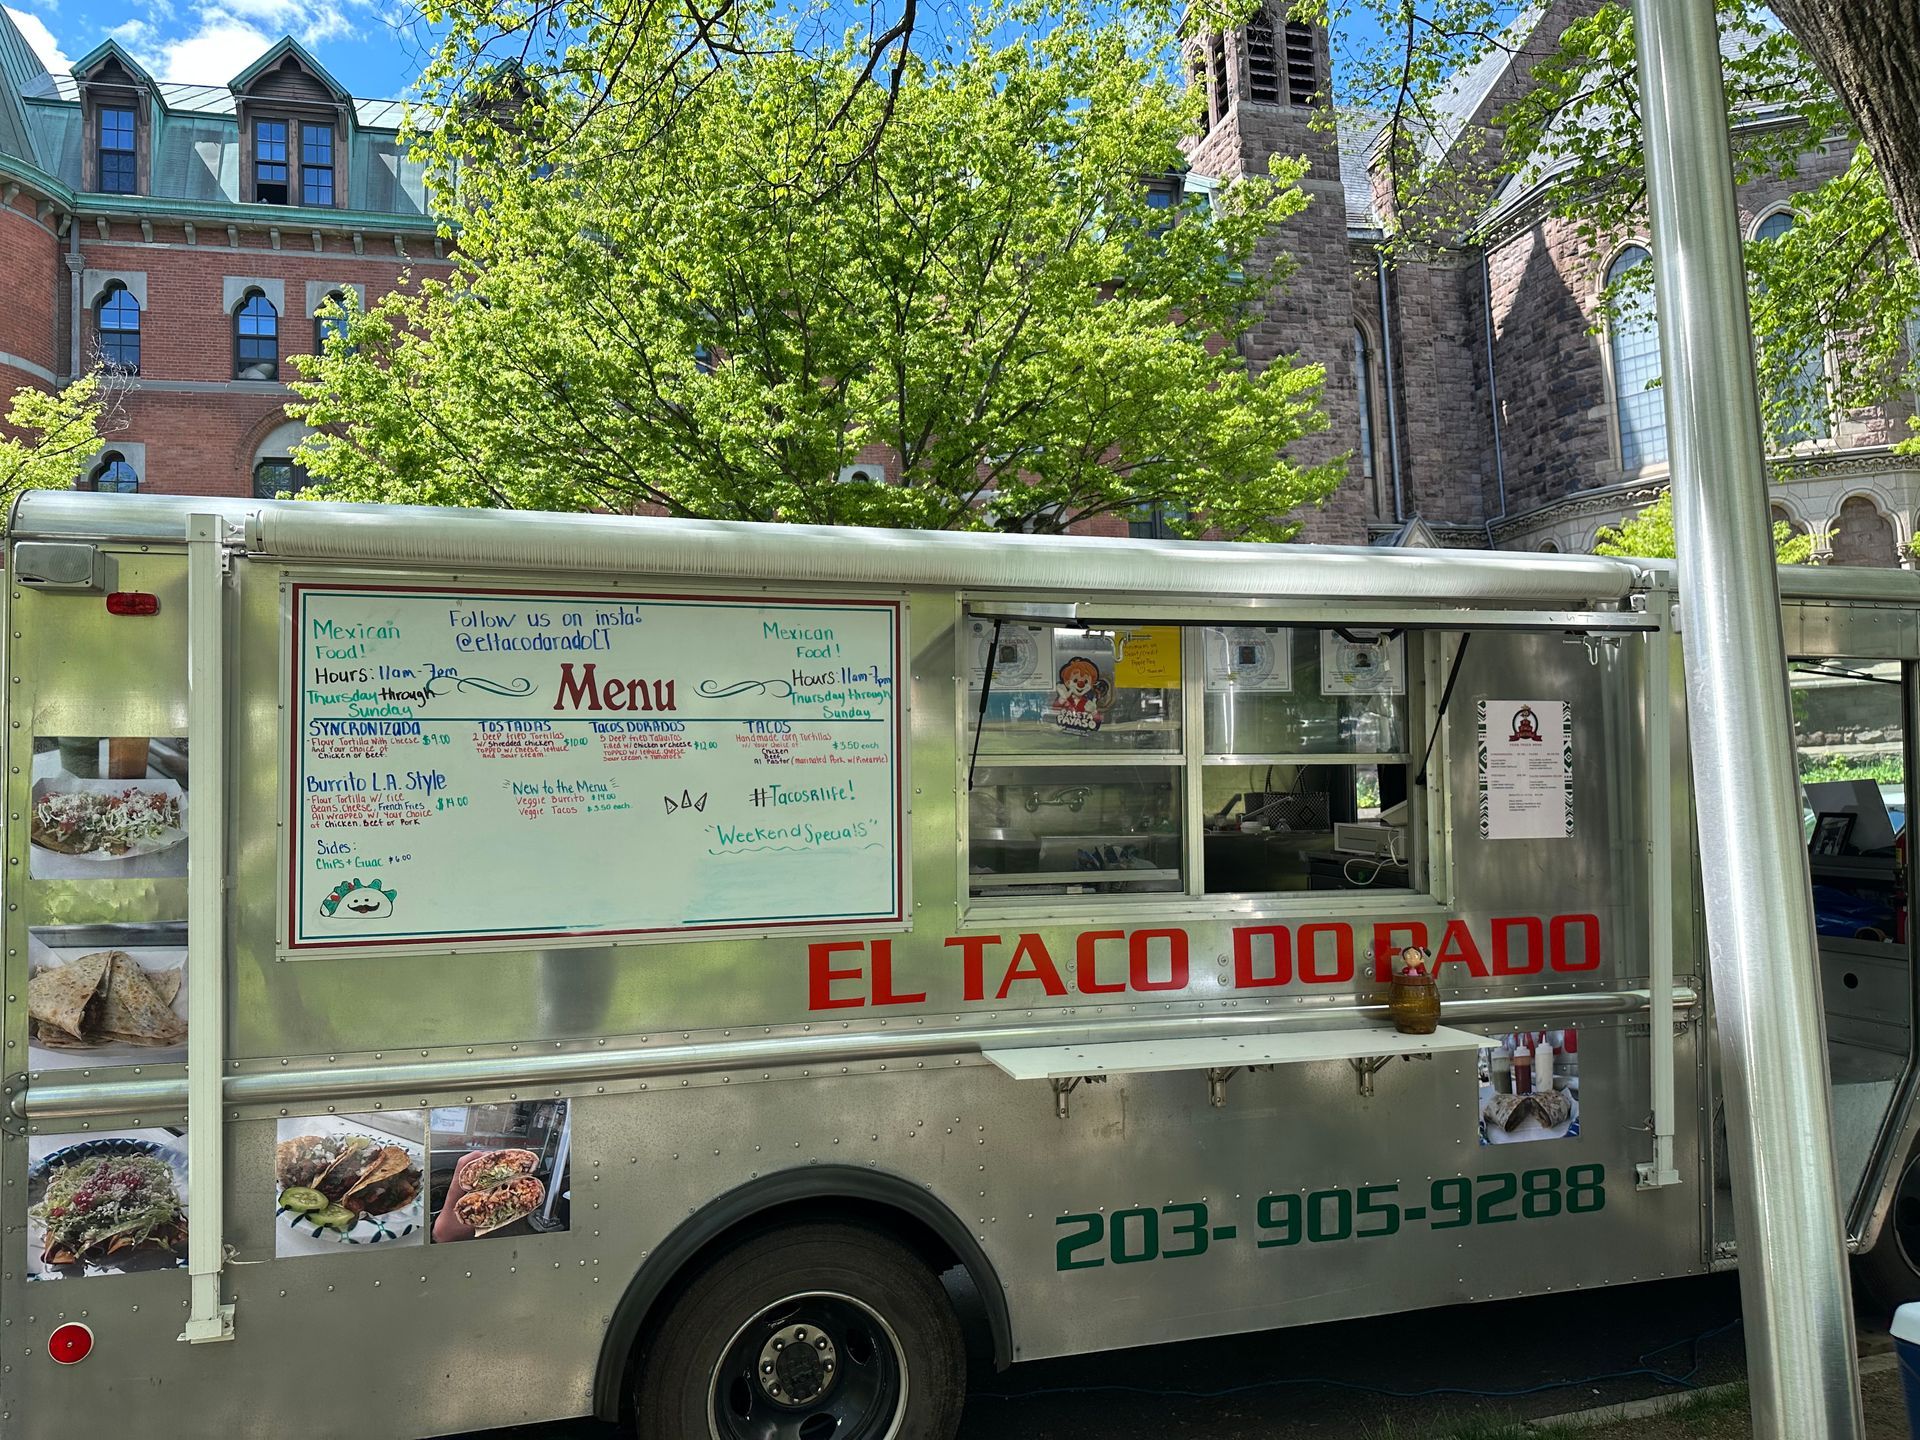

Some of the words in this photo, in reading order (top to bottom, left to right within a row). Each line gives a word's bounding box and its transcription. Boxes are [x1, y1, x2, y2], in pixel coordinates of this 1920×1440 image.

[450, 610, 516, 628] Follow
[527, 612, 551, 627] us
[562, 612, 582, 627] on
[595, 606, 642, 626] insta!
[313, 618, 400, 640] Mexican
[763, 621, 833, 640] Mexican
[315, 644, 366, 660] Food!
[315, 667, 375, 685] Hours:
[792, 669, 840, 687] Hours:
[553, 663, 677, 711] Menu
[307, 689, 378, 706] Thursday
[377, 687, 436, 708] through
[790, 690, 846, 707] Thursday
[848, 689, 891, 705] through
[348, 703, 413, 719] Sunday
[823, 705, 871, 719] Sunday
[1061, 709, 1094, 721] PALETA
[478, 720, 552, 733] TOSTADAS
[626, 720, 686, 733] DORADOS
[743, 720, 791, 734] TACOS
[1057, 714, 1097, 730] PAYASO
[338, 737, 368, 746] Tortilla
[422, 733, 451, 746] $9.00
[472, 733, 479, 741] 2
[530, 732, 565, 740] Tortillas
[599, 734, 606, 742] 5
[379, 745, 389, 753] of
[861, 741, 880, 749] each
[306, 771, 367, 793] Burrito
[372, 772, 402, 791] L.A.
[405, 769, 448, 797] Style
[542, 779, 554, 794] to
[557, 779, 575, 794] the
[576, 780, 608, 794] Menu
[336, 795, 366, 804] Tortilla
[387, 792, 405, 802] rice
[515, 796, 546, 808] Veggie
[551, 794, 585, 804] Burrito
[378, 802, 403, 811] French
[404, 801, 425, 810] Fries
[518, 806, 544, 820] Veggie
[551, 805, 578, 814] Tacos
[310, 821, 320, 829] of
[386, 819, 395, 827] or
[312, 813, 325, 821] All
[317, 839, 357, 855] Sides:
[316, 857, 345, 870] Chips
[355, 856, 384, 868] Guac
[808, 939, 927, 1011] EL
[944, 927, 1190, 1001] TACO
[1055, 1202, 1237, 1272] 203-
[1257, 1163, 1606, 1248] 905-9288
